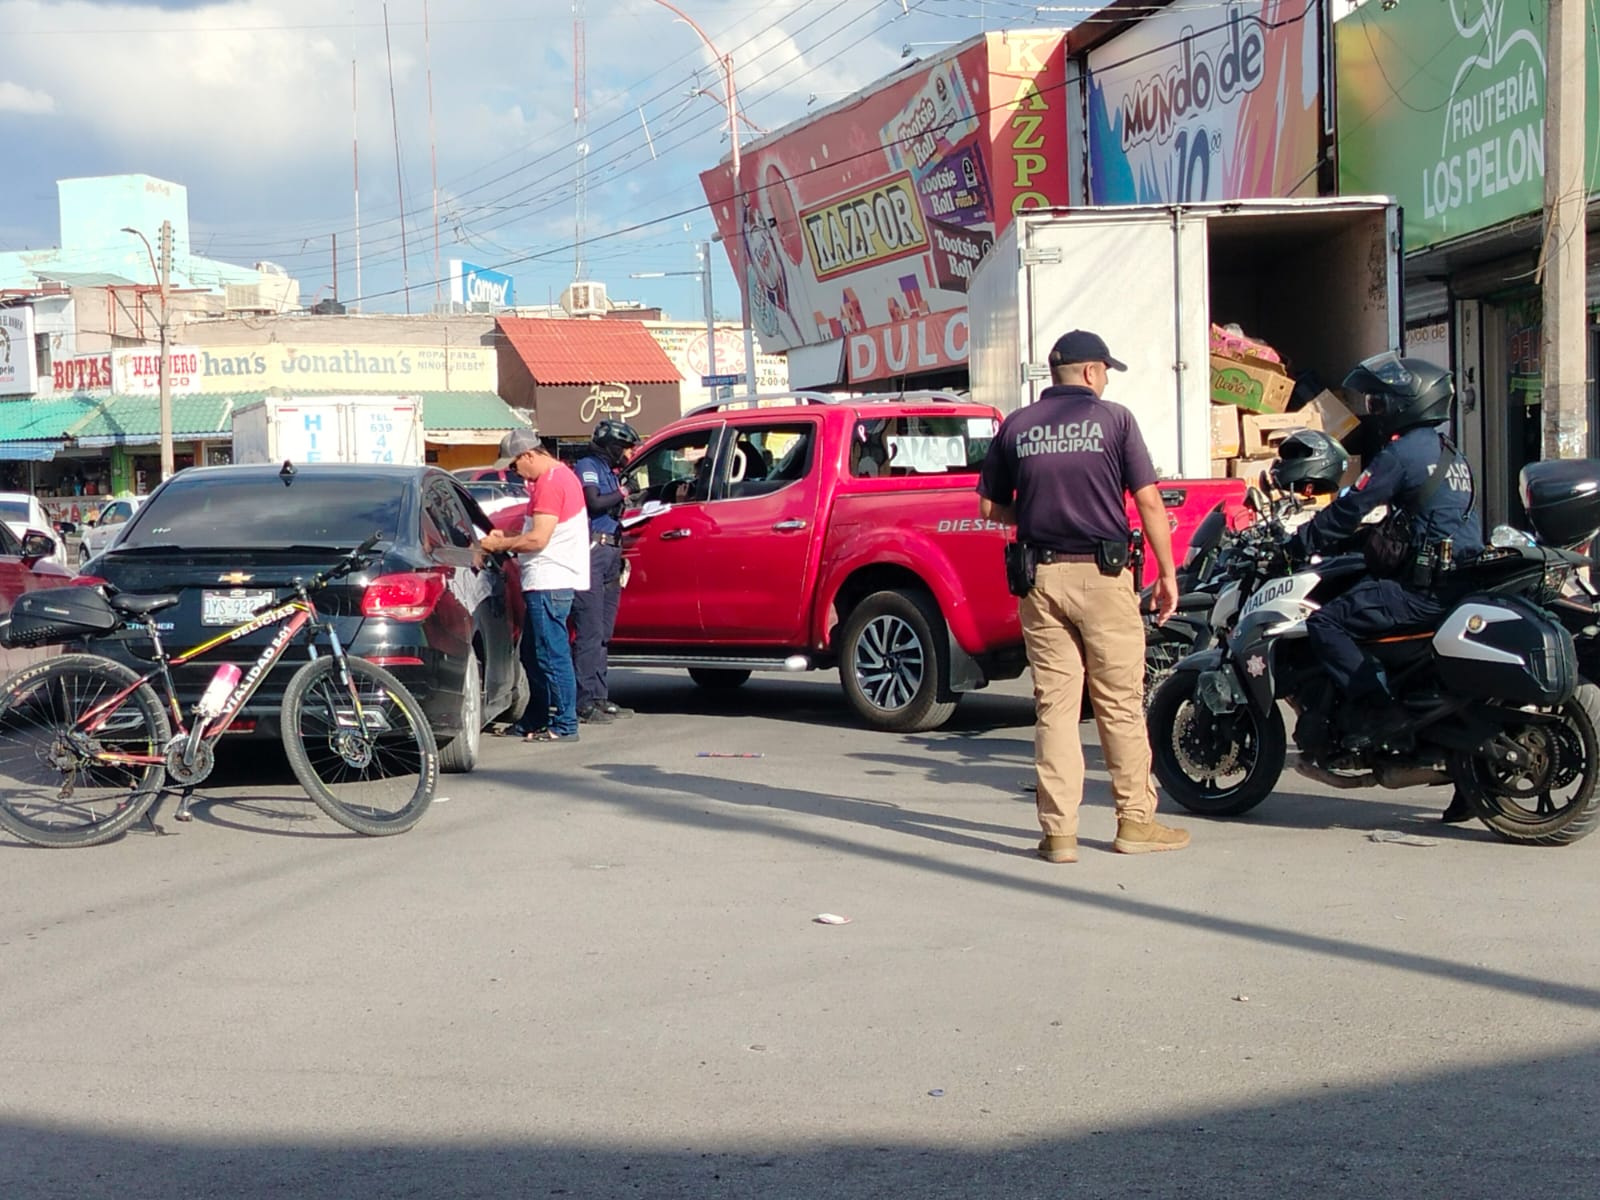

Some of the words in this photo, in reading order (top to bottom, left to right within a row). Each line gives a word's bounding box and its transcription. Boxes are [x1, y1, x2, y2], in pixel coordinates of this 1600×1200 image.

[1219, 7, 1262, 93] de
[1452, 59, 1539, 143] FRUTERÍA
[899, 98, 936, 152] Tootsie
[914, 133, 937, 168] Roll
[1423, 154, 1463, 220] LOS
[1466, 118, 1545, 204] PELON
[930, 191, 956, 216] Roll
[806, 183, 923, 271] KAZPOR
[934, 229, 980, 260] Tootsie
[467, 270, 509, 306] Comex
[851, 311, 969, 379] DULC
[53, 356, 112, 390] BOTAS
[202, 351, 266, 377] han's
[1016, 419, 1105, 445] POLICÍA
[1016, 437, 1105, 459] MUNICIPAL
[937, 518, 1010, 532] DIESEL
[1242, 578, 1294, 616] VIALIDAD
[231, 603, 297, 640] DELICIAS
[222, 646, 276, 713] VIALIDAD
